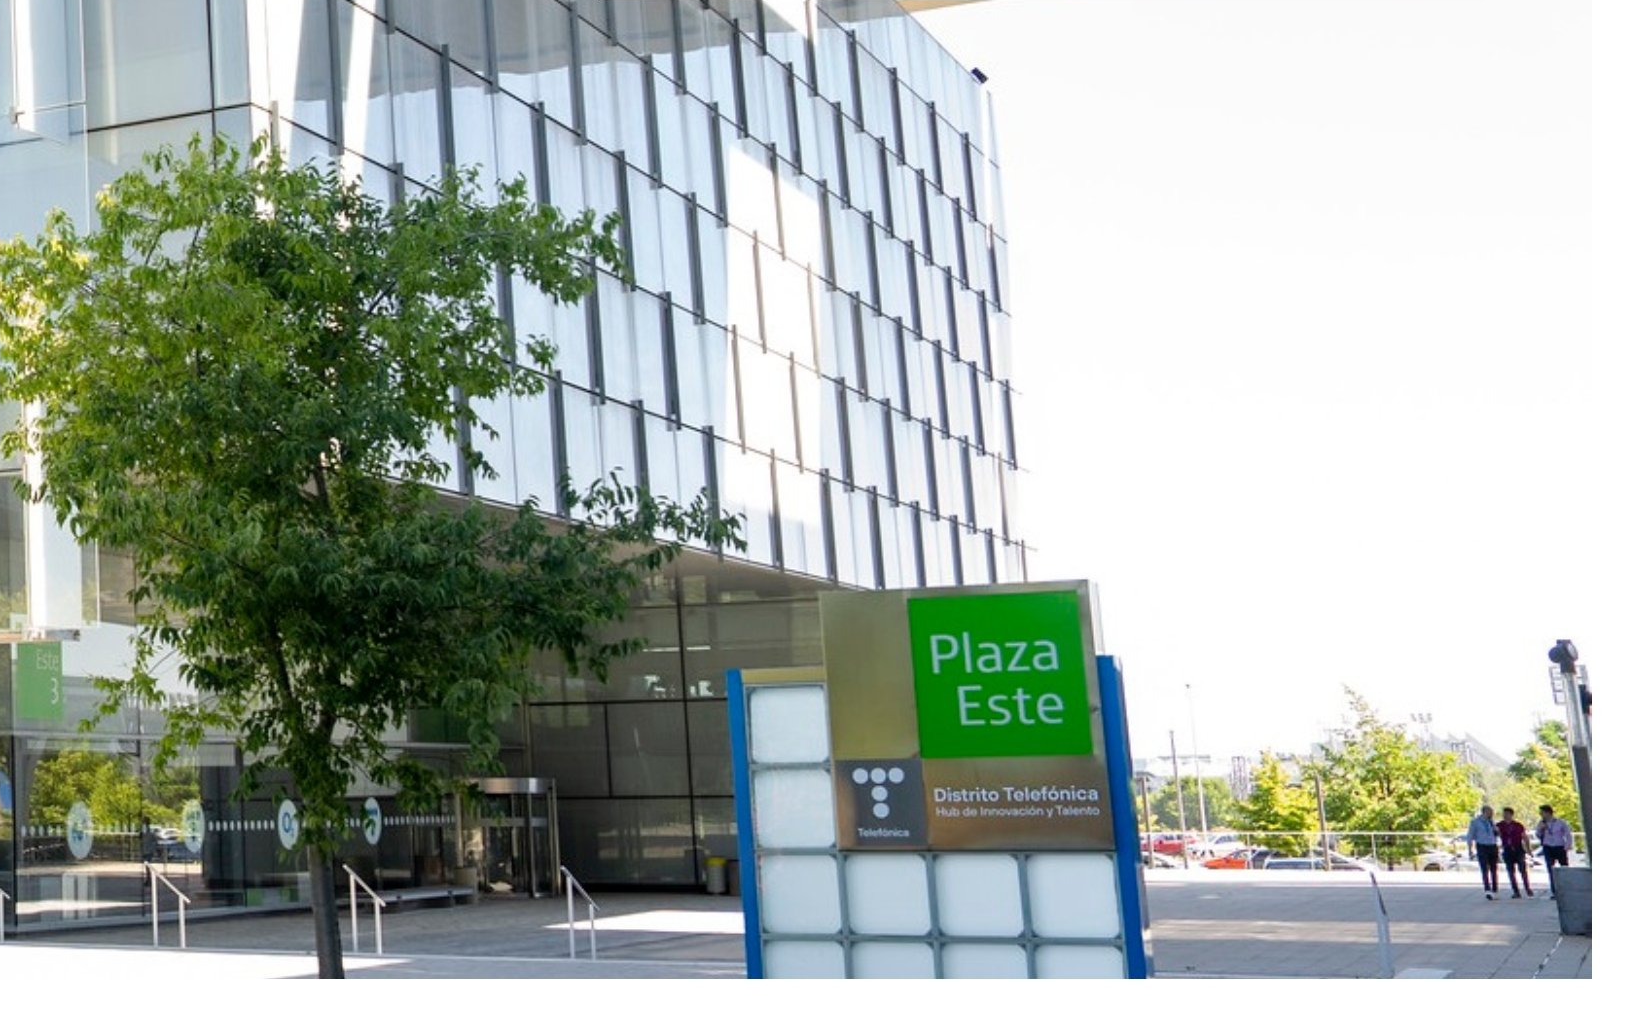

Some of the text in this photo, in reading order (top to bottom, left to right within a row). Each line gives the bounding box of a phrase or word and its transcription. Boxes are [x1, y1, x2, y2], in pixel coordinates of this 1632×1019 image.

[930, 631, 1059, 674] Plaza
[50, 677, 59, 704] 3
[957, 684, 1064, 726] Este
[933, 785, 1099, 802] Distrito Telefónica
[935, 804, 1100, 817] Hub de Innovación y Talento
[857, 827, 909, 837] Telefónica
